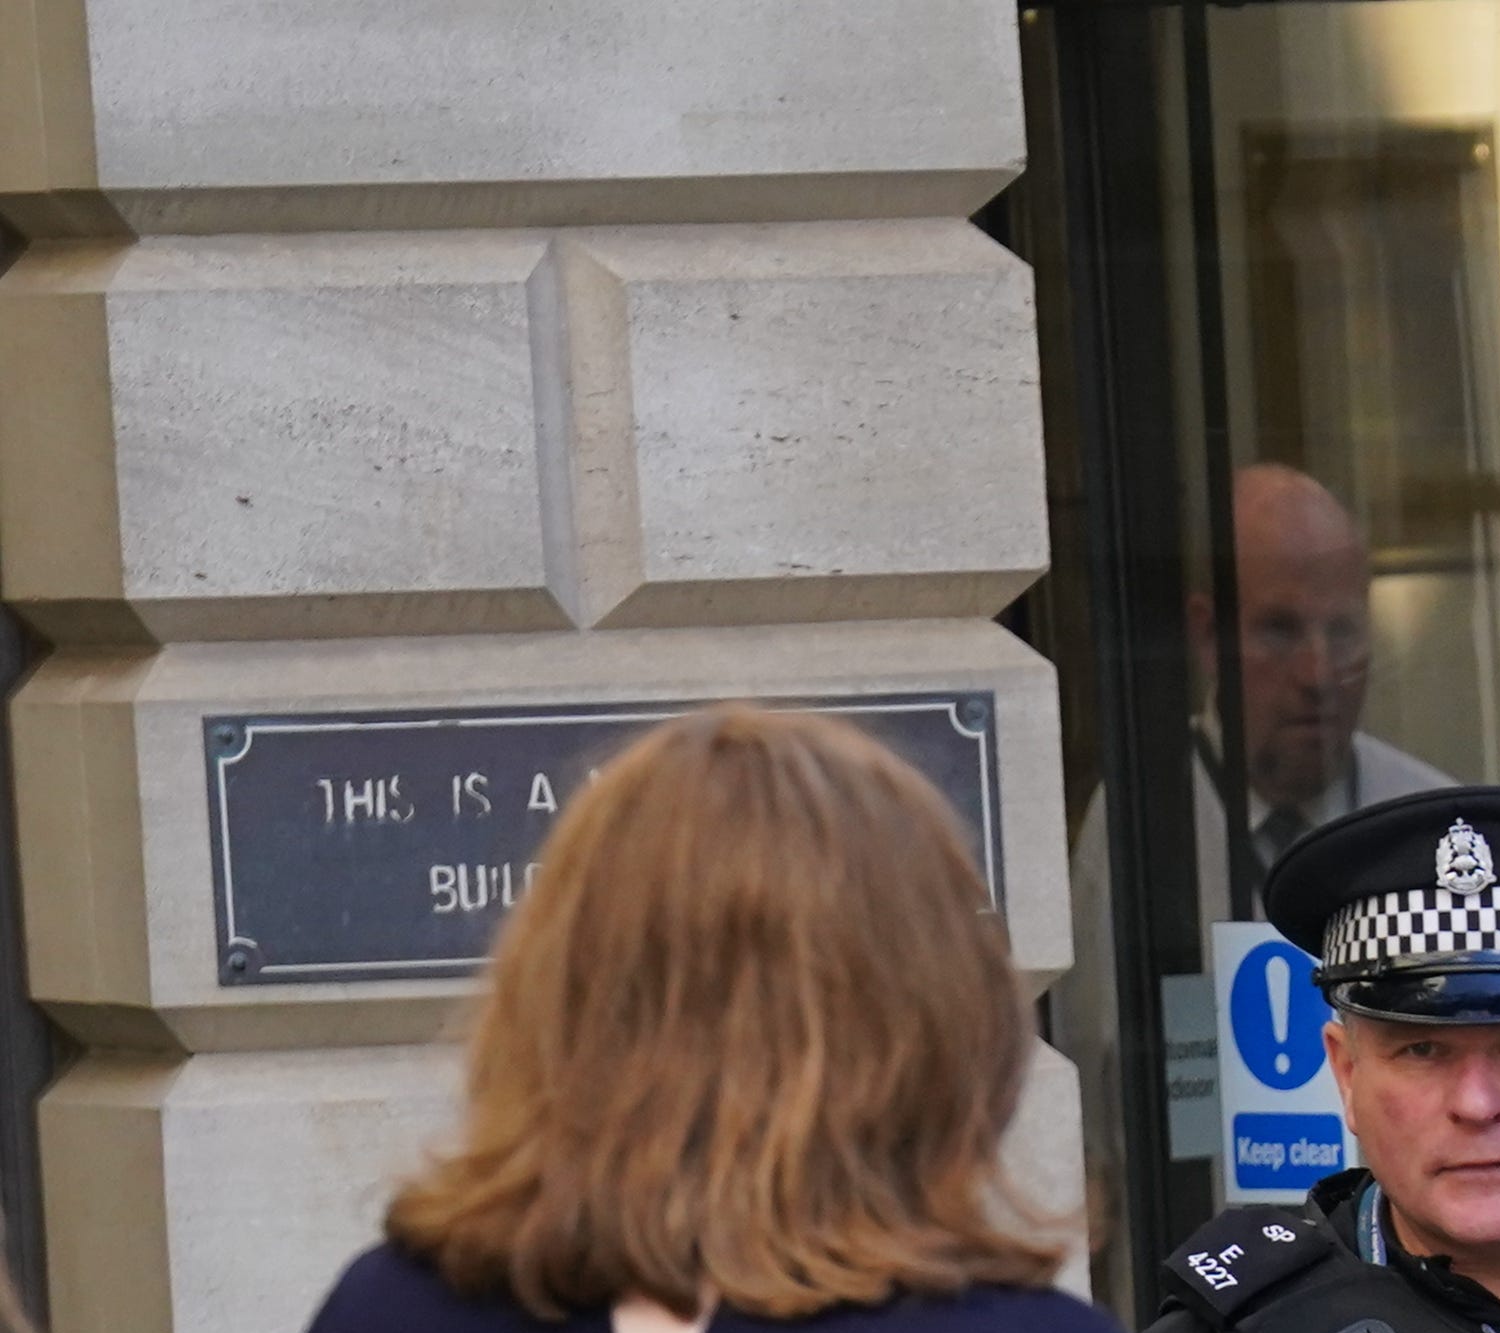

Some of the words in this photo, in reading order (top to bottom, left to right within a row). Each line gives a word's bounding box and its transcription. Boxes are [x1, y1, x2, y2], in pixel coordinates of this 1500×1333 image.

[315, 774, 415, 824] THIS
[452, 771, 493, 817] IS
[527, 772, 558, 814] A
[1237, 1137, 1285, 1172] Keep
[1289, 1138, 1341, 1167] clear
[1262, 1223, 1297, 1244] SP
[1187, 1251, 1239, 1291] 4227
[1219, 1244, 1245, 1265] E
